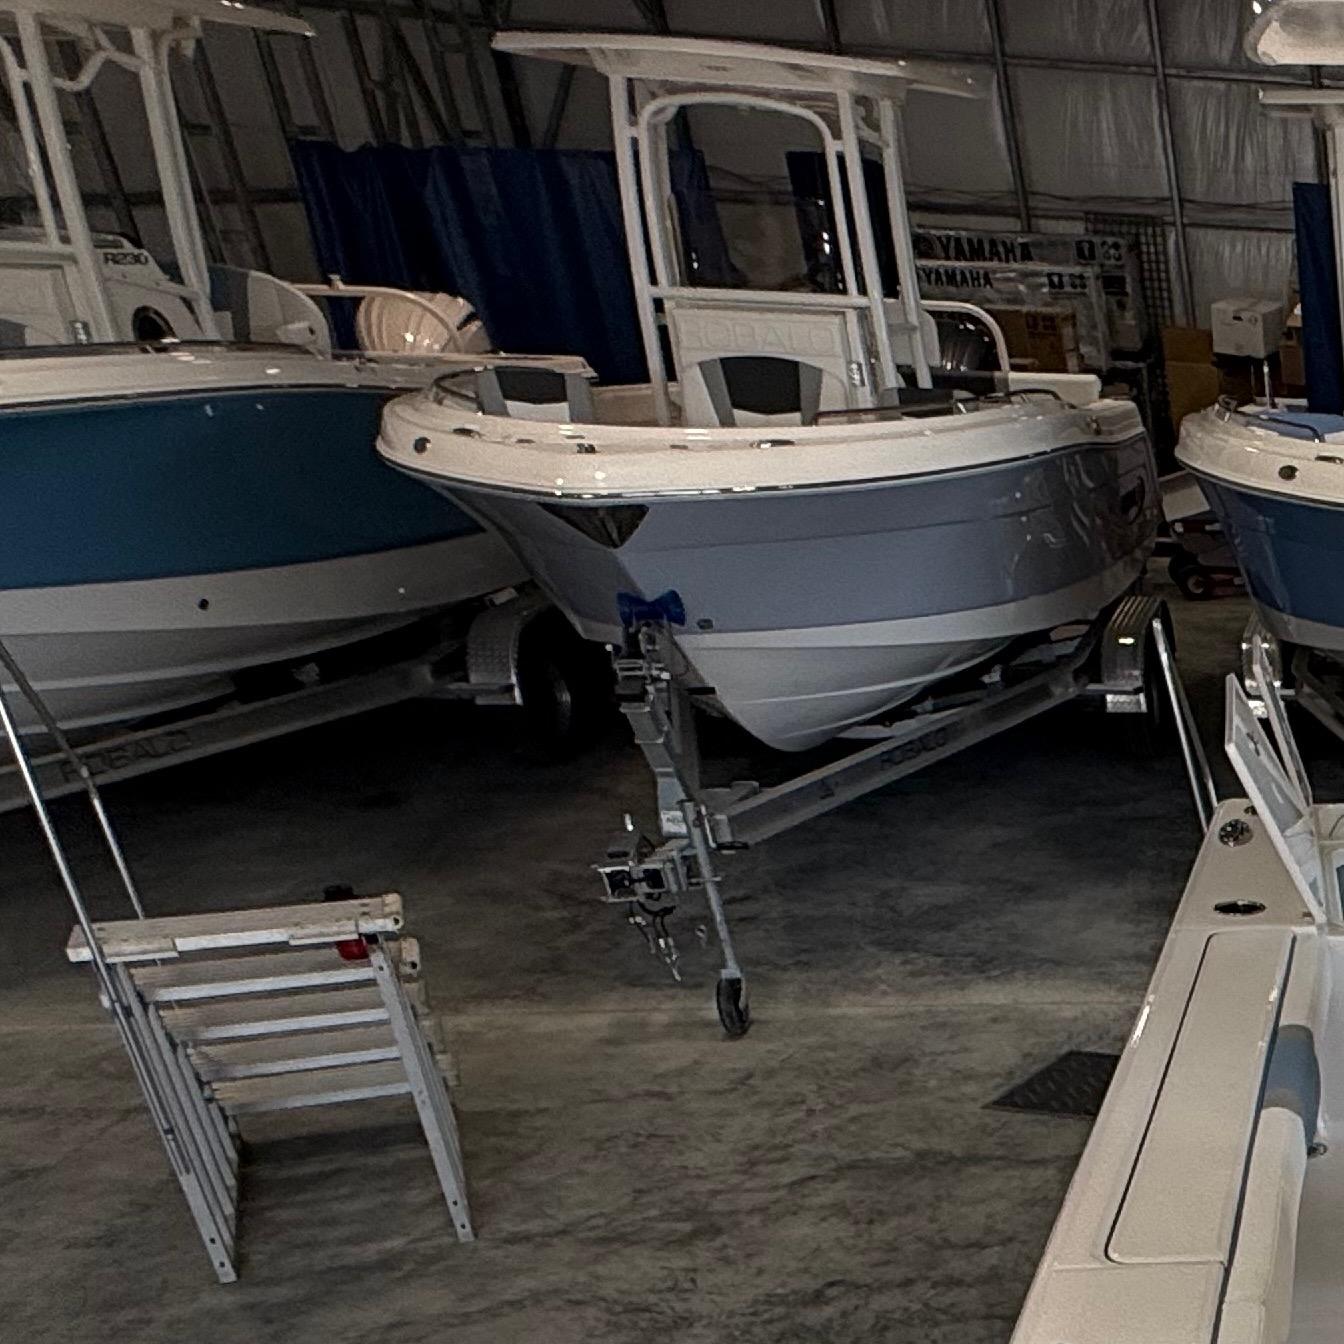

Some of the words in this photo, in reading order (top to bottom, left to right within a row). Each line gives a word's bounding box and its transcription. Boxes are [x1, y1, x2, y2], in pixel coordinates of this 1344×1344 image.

[102, 251, 149, 267] R230
[938, 236, 1034, 263] YAMAHA
[921, 266, 994, 290] YAMAHA
